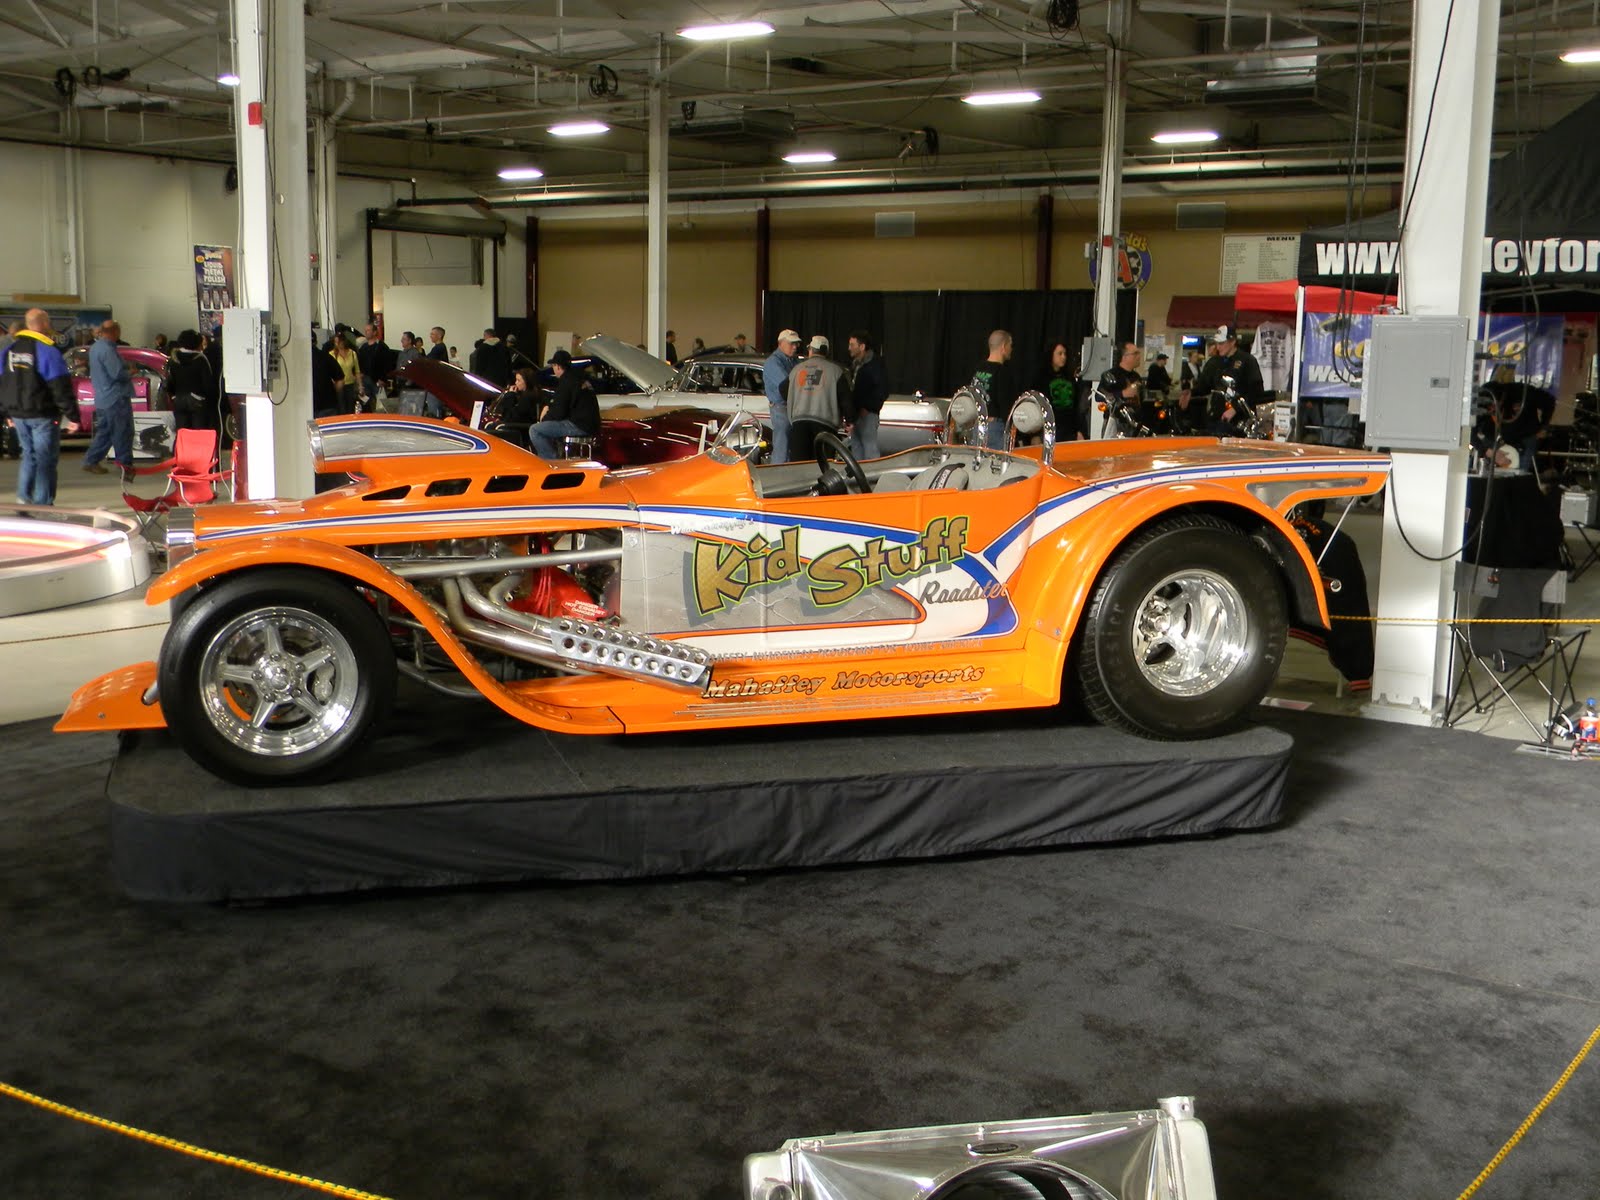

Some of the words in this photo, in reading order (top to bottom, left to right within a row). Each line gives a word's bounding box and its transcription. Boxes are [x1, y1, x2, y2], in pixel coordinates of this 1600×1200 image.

[203, 267, 224, 275] METAL
[203, 275, 226, 283] POLISH
[693, 525, 802, 616] Kid
[806, 516, 969, 609] Stuff
[919, 580, 1008, 604] Roadster
[710, 651, 748, 662] SAFETY
[702, 675, 827, 699] Mahaffey
[832, 665, 985, 690] Motorsports
